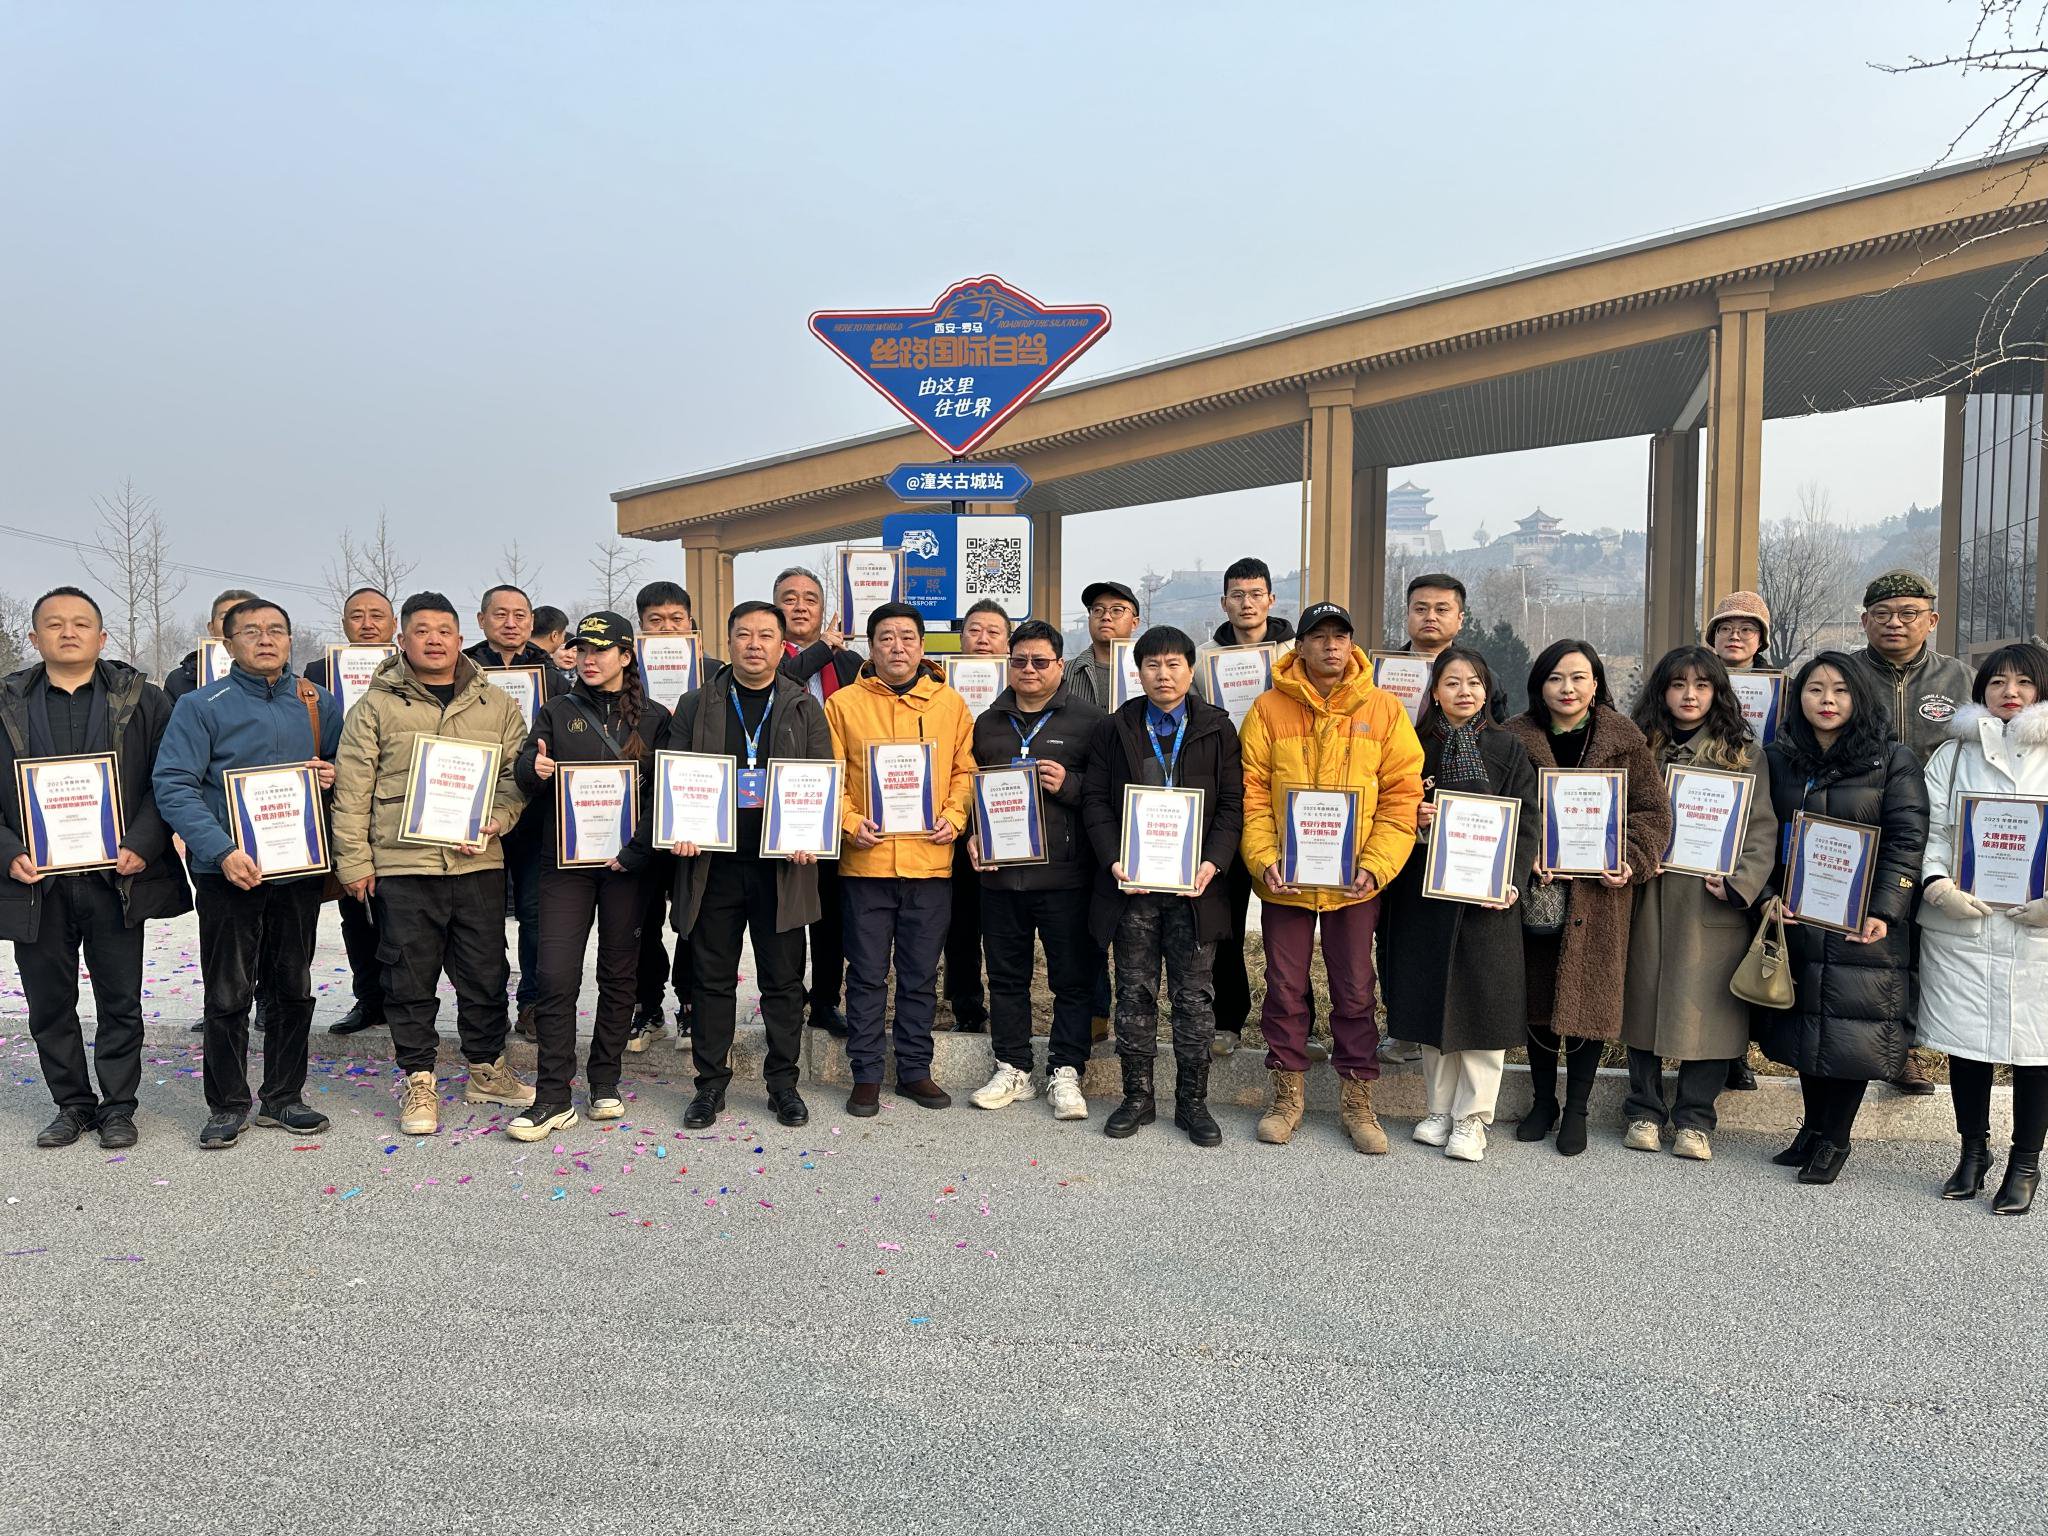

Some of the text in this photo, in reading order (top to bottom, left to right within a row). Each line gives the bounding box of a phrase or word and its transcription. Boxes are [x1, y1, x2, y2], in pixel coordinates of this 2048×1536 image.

[870, 333, 1048, 370] 丝路国际自驾
[918, 376, 975, 397] 由这里
[934, 396, 993, 418] 往世界
[906, 472, 1004, 491] @潼关古城站
[1982, 840, 2026, 852] 旅游度假区
[1812, 851, 1850, 866] 长安三千里
